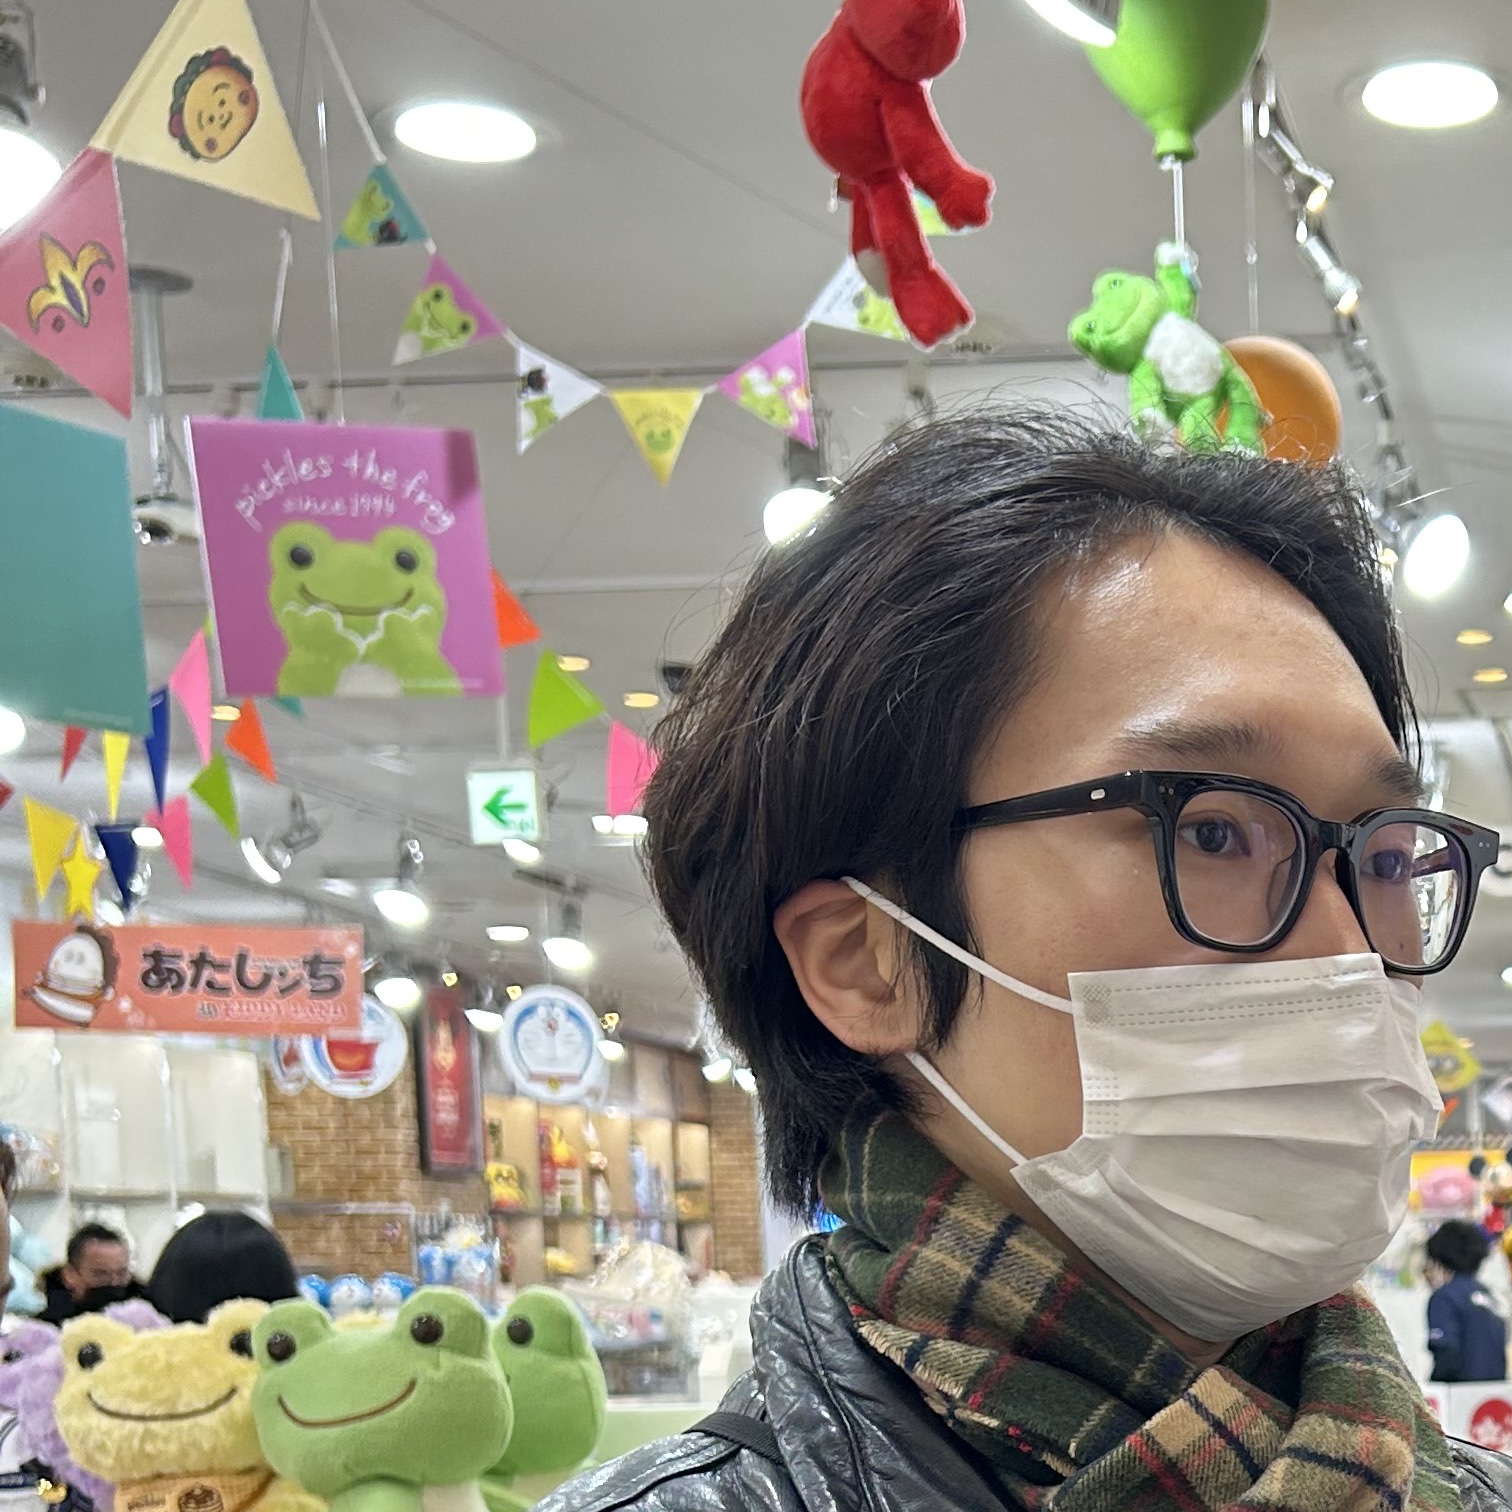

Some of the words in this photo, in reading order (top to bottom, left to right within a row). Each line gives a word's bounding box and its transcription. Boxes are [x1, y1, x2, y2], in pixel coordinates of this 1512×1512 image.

[342, 448, 397, 491] the
[402, 469, 456, 535] frog
[141, 945, 346, 997] あたしンち
